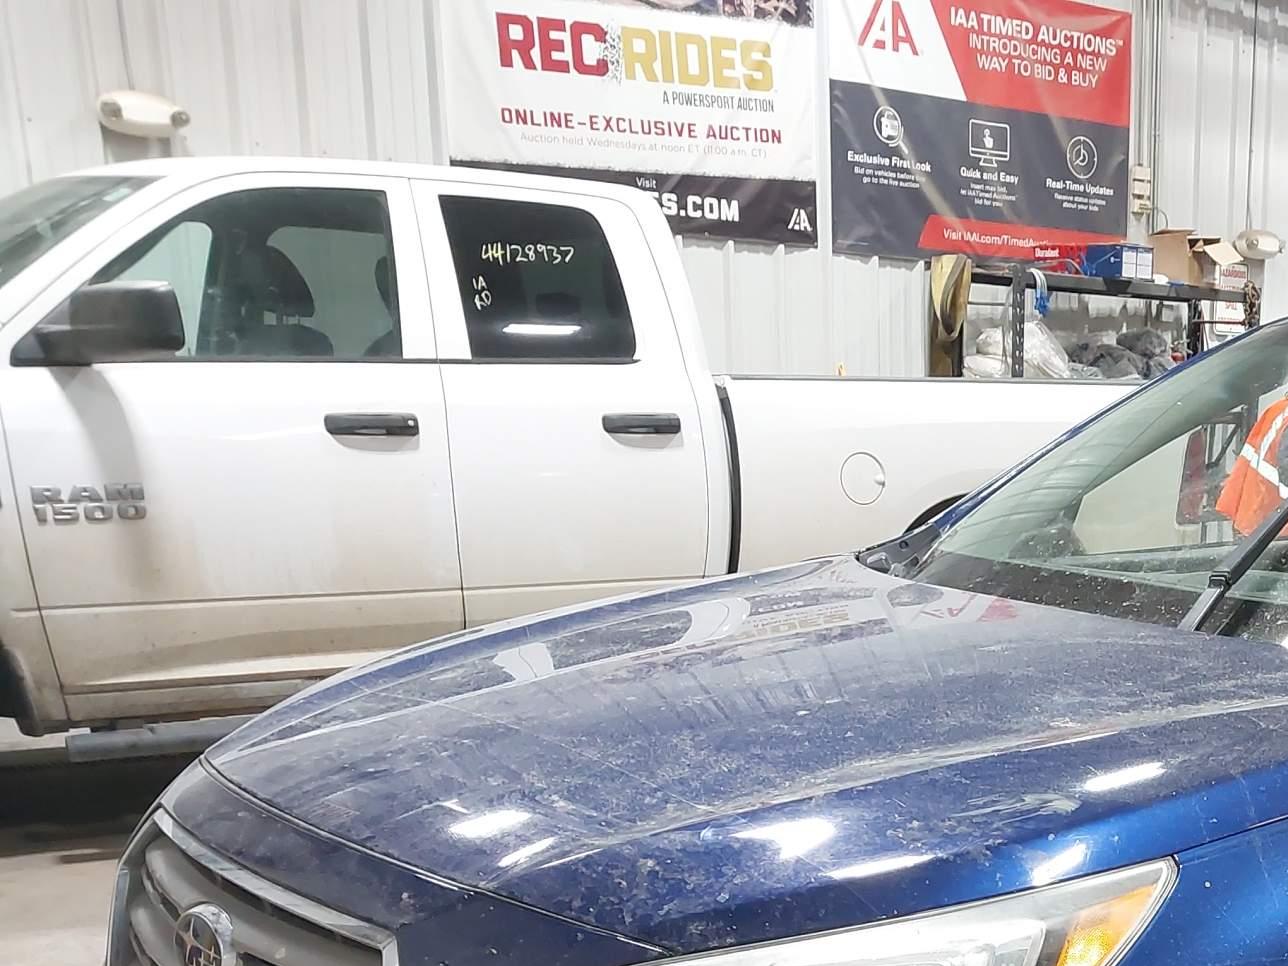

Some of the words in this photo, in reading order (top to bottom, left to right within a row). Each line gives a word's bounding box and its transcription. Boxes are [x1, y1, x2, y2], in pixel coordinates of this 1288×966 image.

[950, 6, 978, 30] IAA
[980, 13, 1034, 40] TIMED
[496, 12, 609, 77] REC
[620, 26, 774, 92] RIDES
[969, 32, 1061, 64] INTRODUCING
[1064, 52, 1074, 67] A
[1077, 53, 1108, 72] NEW
[976, 53, 1009, 73] WAY
[1012, 59, 1031, 77] TO
[1034, 64, 1055, 81] BID
[1058, 68, 1068, 84] &
[1072, 71, 1098, 89] BUY
[662, 90, 670, 105] A
[672, 91, 734, 110] POWERSPORT
[737, 95, 774, 112] AUCTION
[501, 107, 697, 139] ONLINE-EXCLUSIVE
[706, 124, 782, 144] AUCTION
[847, 150, 890, 166] Exclusive
[892, 156, 910, 169] First
[911, 160, 931, 173] Look
[636, 177, 657, 189] Visit
[960, 166, 981, 179] Quick
[982, 171, 998, 181] and
[999, 171, 1019, 185] Easy
[1046, 178, 1084, 192] Real-Time
[1085, 183, 1114, 195] Updates
[647, 190, 740, 222] S.COM
[943, 228, 962, 241] Visit
[481, 243, 575, 266] 44128937
[30, 483, 145, 503] RAM
[32, 503, 147, 525] 1500
